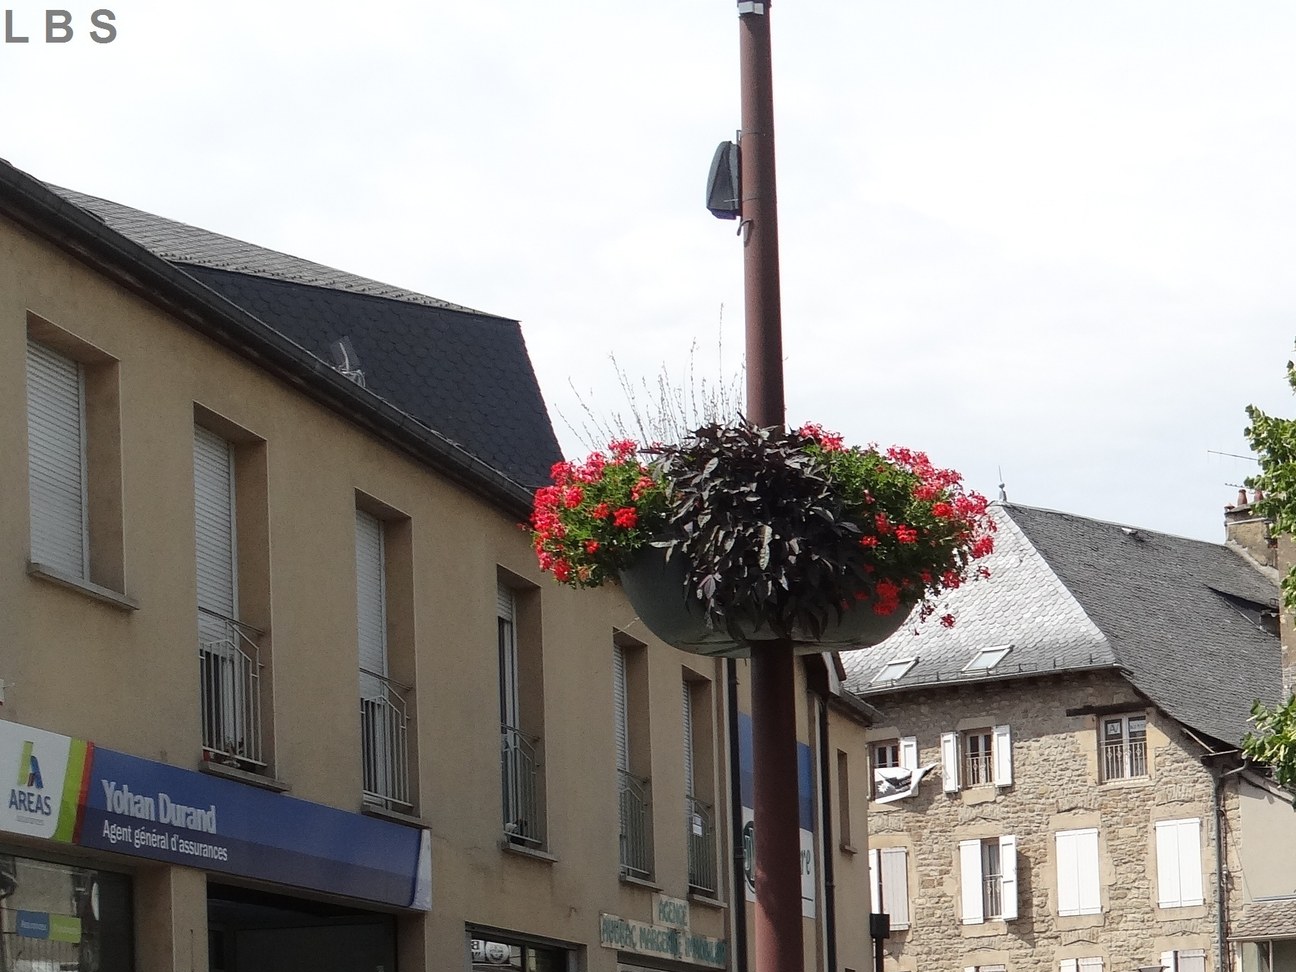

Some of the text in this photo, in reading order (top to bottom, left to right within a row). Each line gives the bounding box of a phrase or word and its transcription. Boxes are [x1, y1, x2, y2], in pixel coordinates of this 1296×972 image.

[9, 788, 51, 816] AREAS
[101, 779, 217, 835] Yohan Durand
[103, 819, 228, 861] Agent général d'assurances
